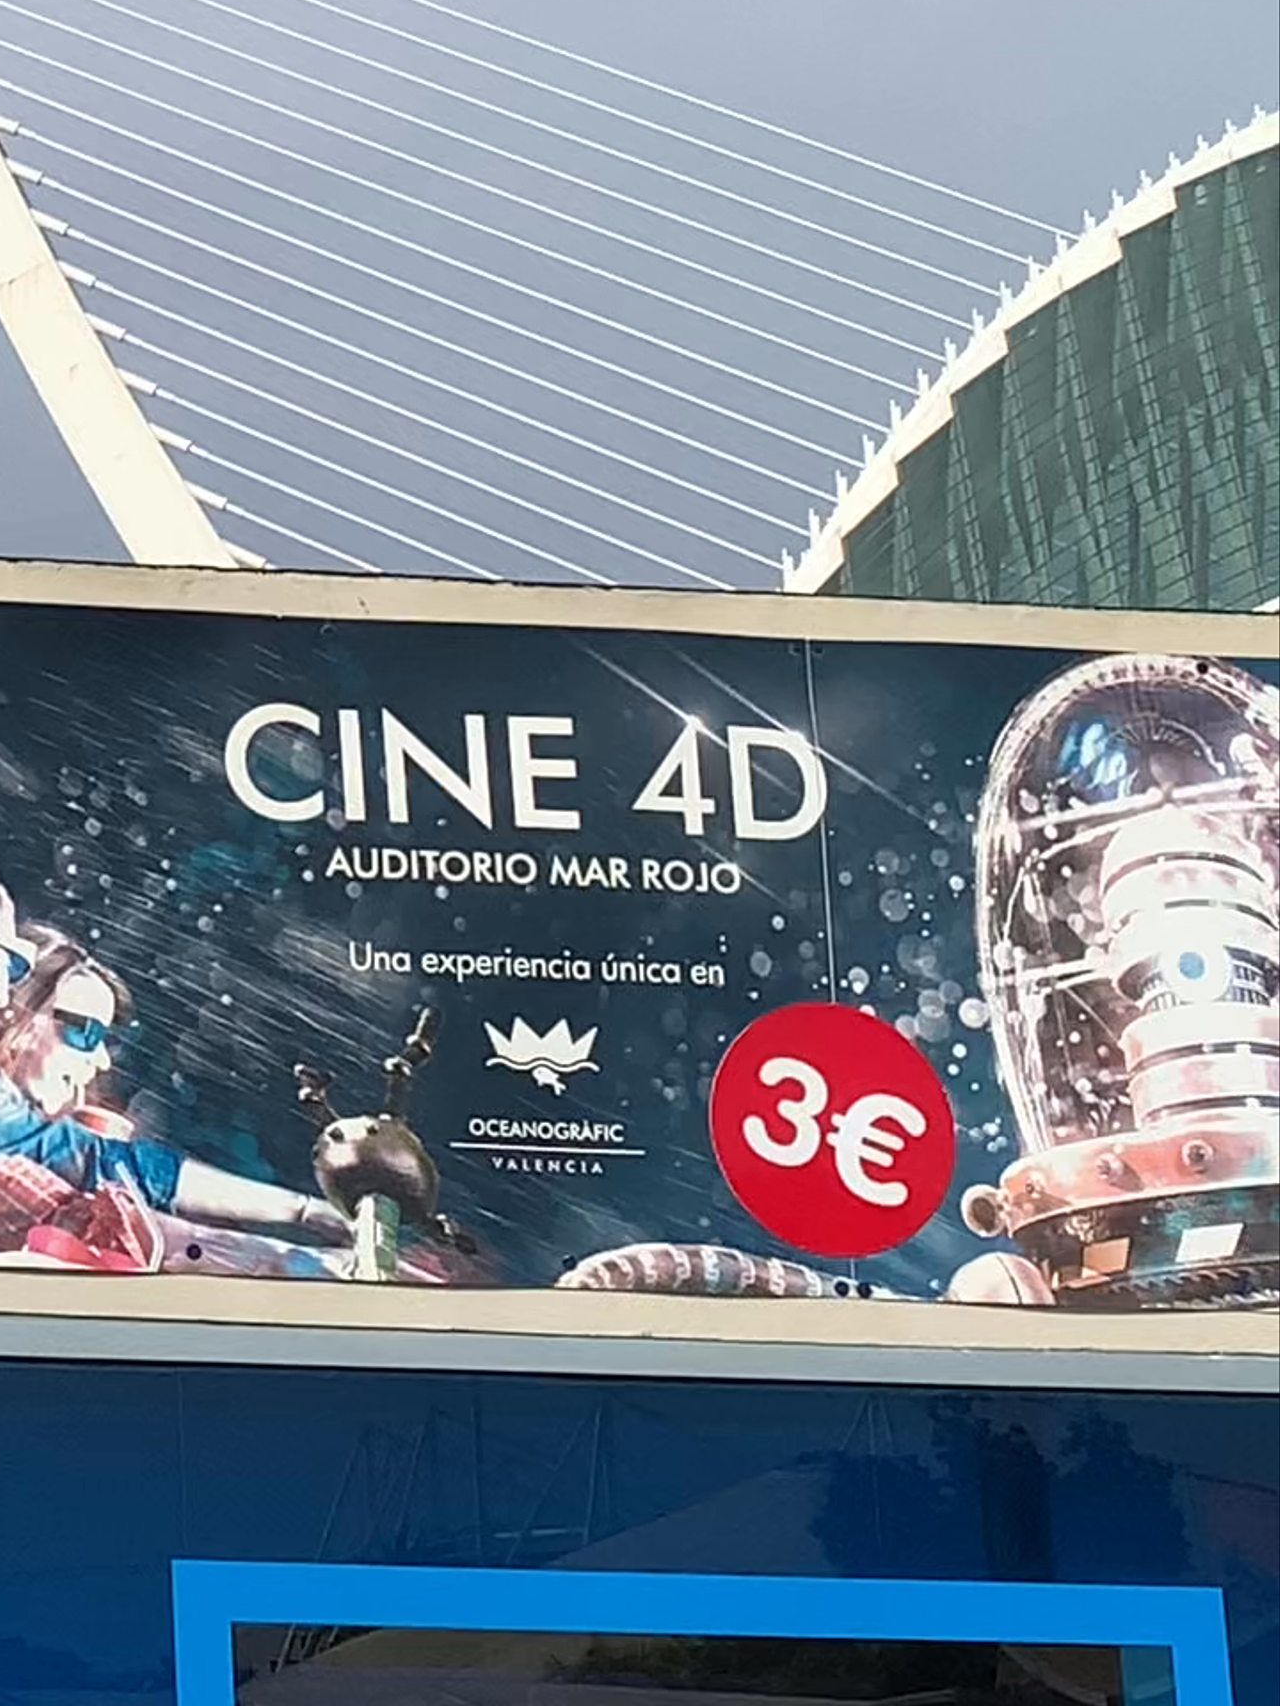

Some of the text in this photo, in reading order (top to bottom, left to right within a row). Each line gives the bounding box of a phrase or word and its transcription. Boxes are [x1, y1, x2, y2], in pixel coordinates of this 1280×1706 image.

[224, 701, 828, 841] CINE 4D
[326, 846, 742, 896] AUDITORIO MAR ROJO
[349, 941, 726, 986] Una experiencia única en
[468, 1118, 625, 1143] OCEANOGRÀFIC
[741, 1054, 926, 1207] 3€
[491, 1157, 604, 1174] VALENCIA
